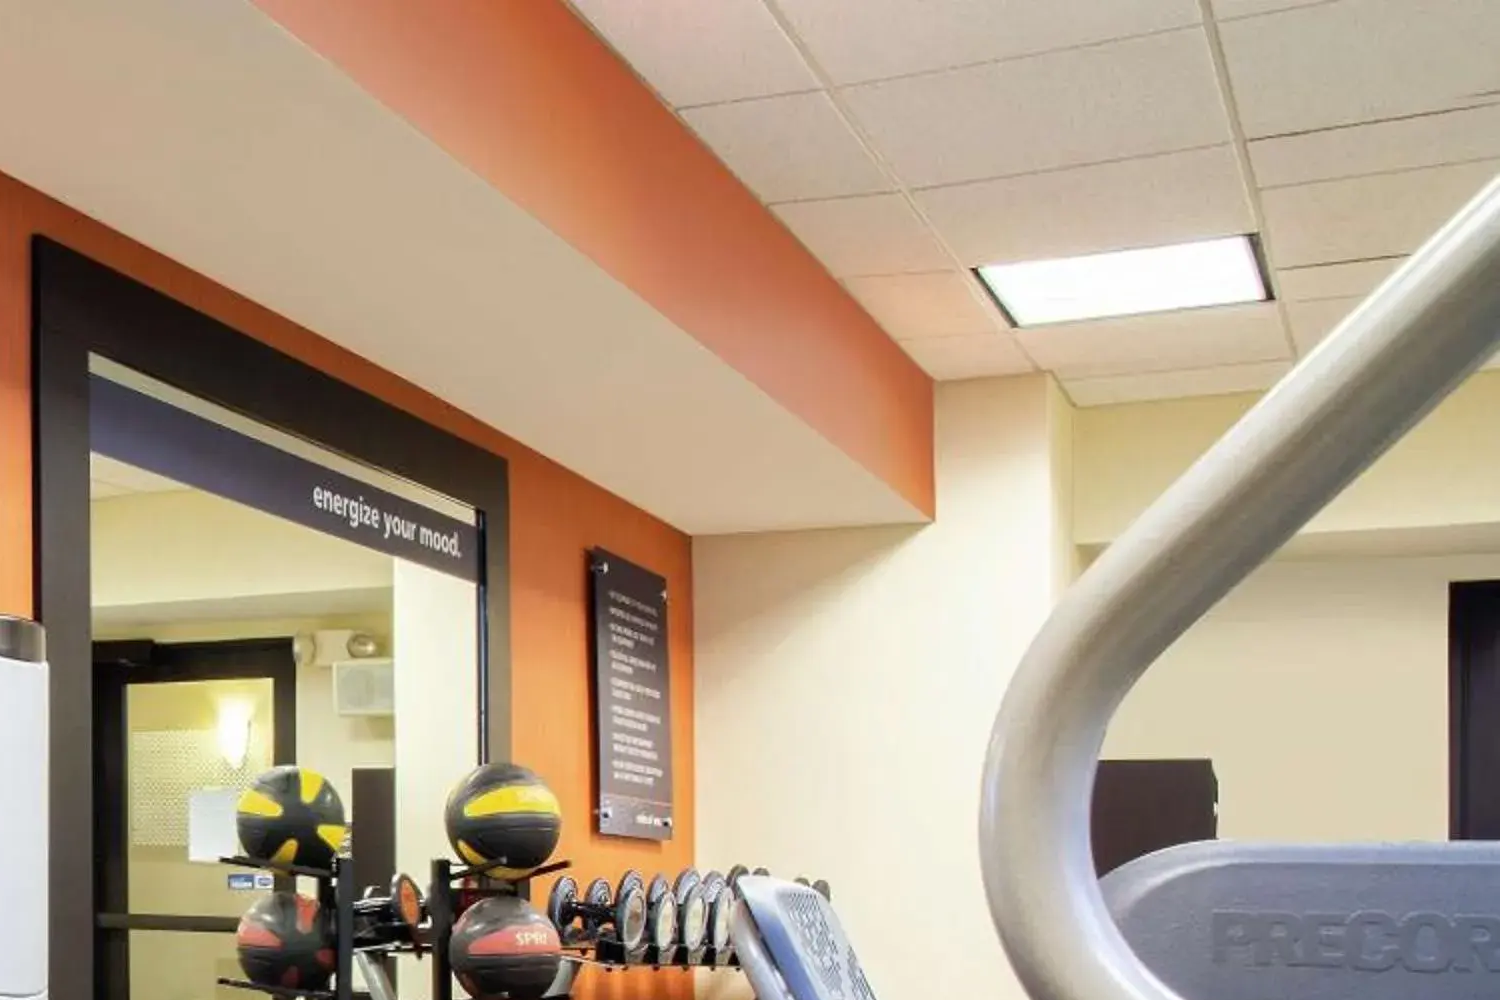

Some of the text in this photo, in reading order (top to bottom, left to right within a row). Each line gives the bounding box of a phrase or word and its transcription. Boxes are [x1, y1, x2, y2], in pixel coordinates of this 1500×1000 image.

[312, 486, 463, 558] energize your mood.
[1210, 908, 1500, 974] PRECOR
